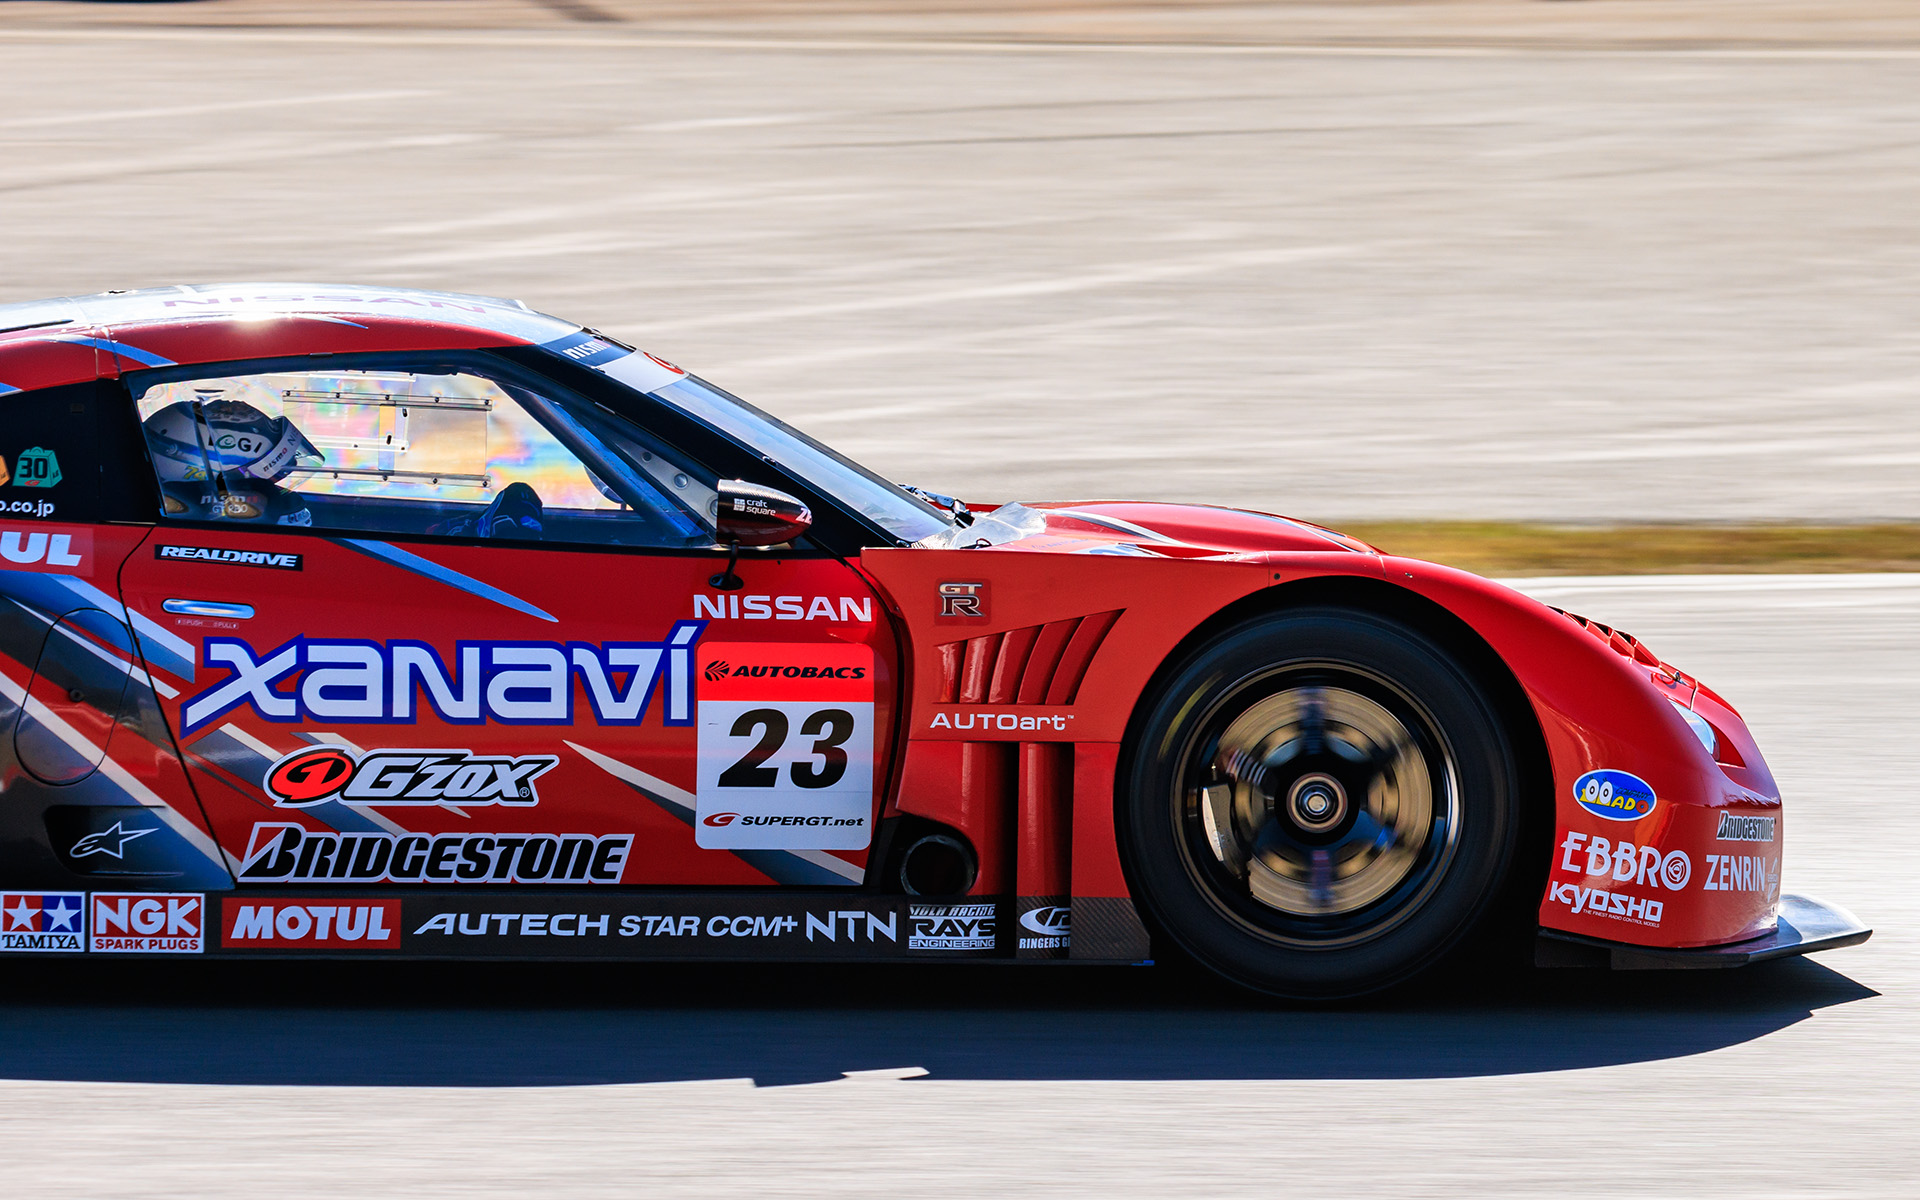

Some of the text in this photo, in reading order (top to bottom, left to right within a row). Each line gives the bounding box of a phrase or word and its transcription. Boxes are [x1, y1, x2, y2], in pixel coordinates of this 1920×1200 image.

[19, 457, 48, 479] 30
[746, 506, 776, 517] square
[160, 545, 298, 568] REALDRIVE
[939, 582, 983, 595] GT
[693, 594, 872, 622] NISSAN
[732, 665, 866, 679] AUTOBACS
[717, 708, 855, 789] 23
[741, 815, 865, 827] SUPERGT.net
[1716, 810, 1775, 841] BRIDGESTONE
[243, 824, 631, 882] BRIDGESTONE
[1561, 831, 1691, 891] EBBRO
[1703, 854, 1766, 892] ZENRIN
[909, 906, 996, 916] VOLK RACING
[1549, 880, 1664, 922] KYOSHO
[96, 897, 200, 937] NGK
[230, 906, 391, 941] MOTUL
[413, 913, 610, 936] AUTECH
[618, 915, 798, 937] STAR CCM+
[805, 911, 897, 942] NTN
[911, 919, 996, 937] RAYS
[2, 934, 81, 950] TAMIYA
[95, 938, 199, 950] SPARK PLUGS
[909, 940, 995, 948] ENGINEERING
[1018, 937, 1060, 949] RINGERS
